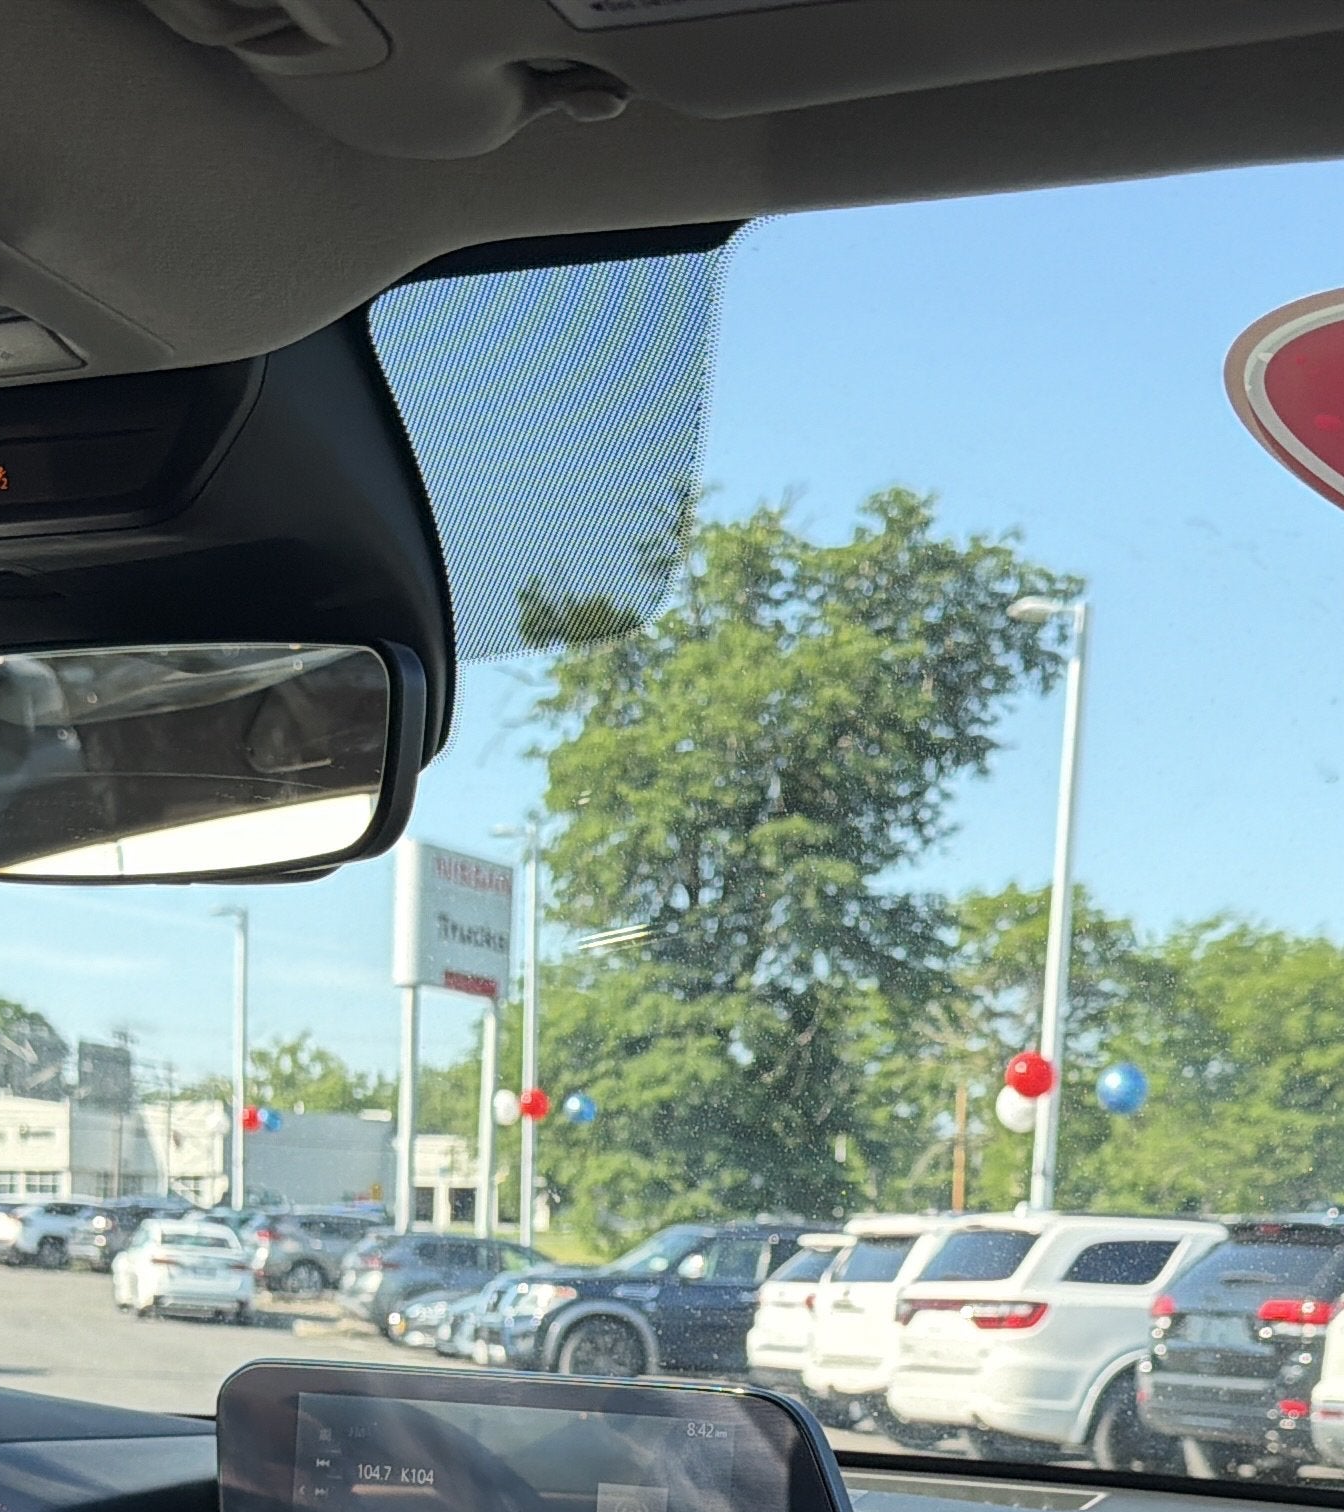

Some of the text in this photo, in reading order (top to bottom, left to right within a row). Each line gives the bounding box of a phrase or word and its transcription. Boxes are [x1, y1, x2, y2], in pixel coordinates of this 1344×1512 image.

[686, 1421, 714, 1438] 8:42
[357, 1463, 434, 1485] 104.7 K104
